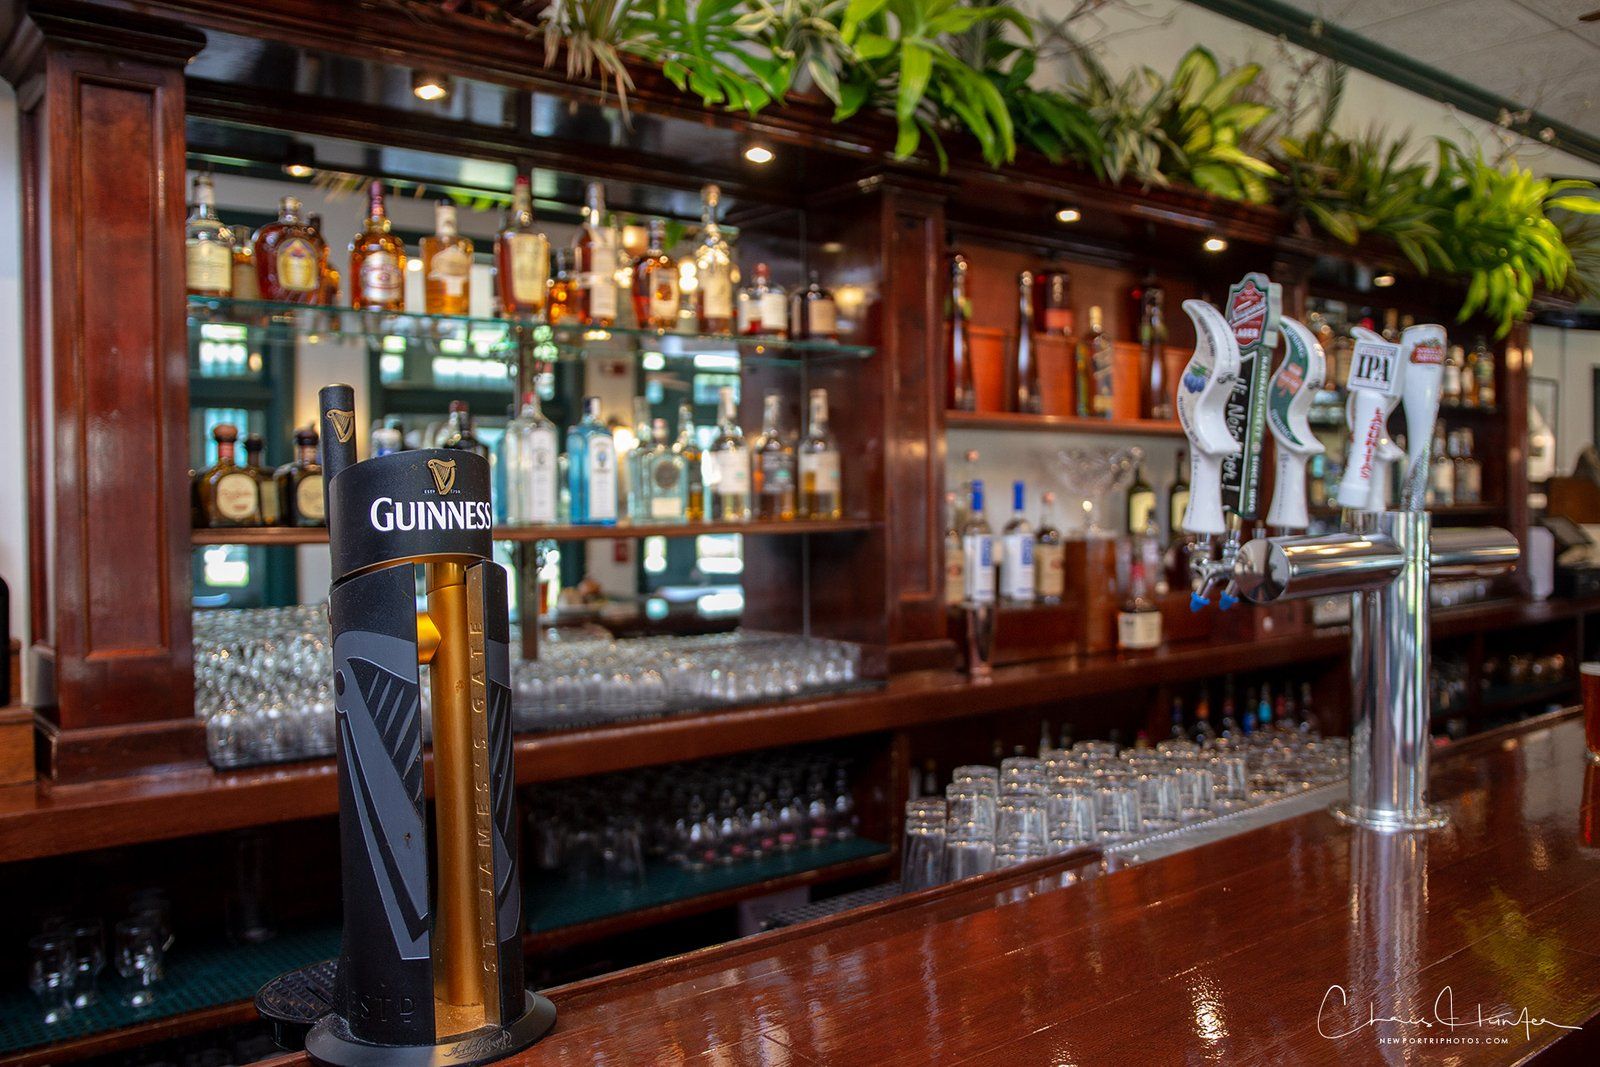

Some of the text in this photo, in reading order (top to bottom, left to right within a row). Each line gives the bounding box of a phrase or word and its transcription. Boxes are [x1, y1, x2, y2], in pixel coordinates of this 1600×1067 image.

[1357, 354, 1390, 381] IPA
[370, 497, 491, 531] GUINNESS
[470, 622, 484, 713] GATE
